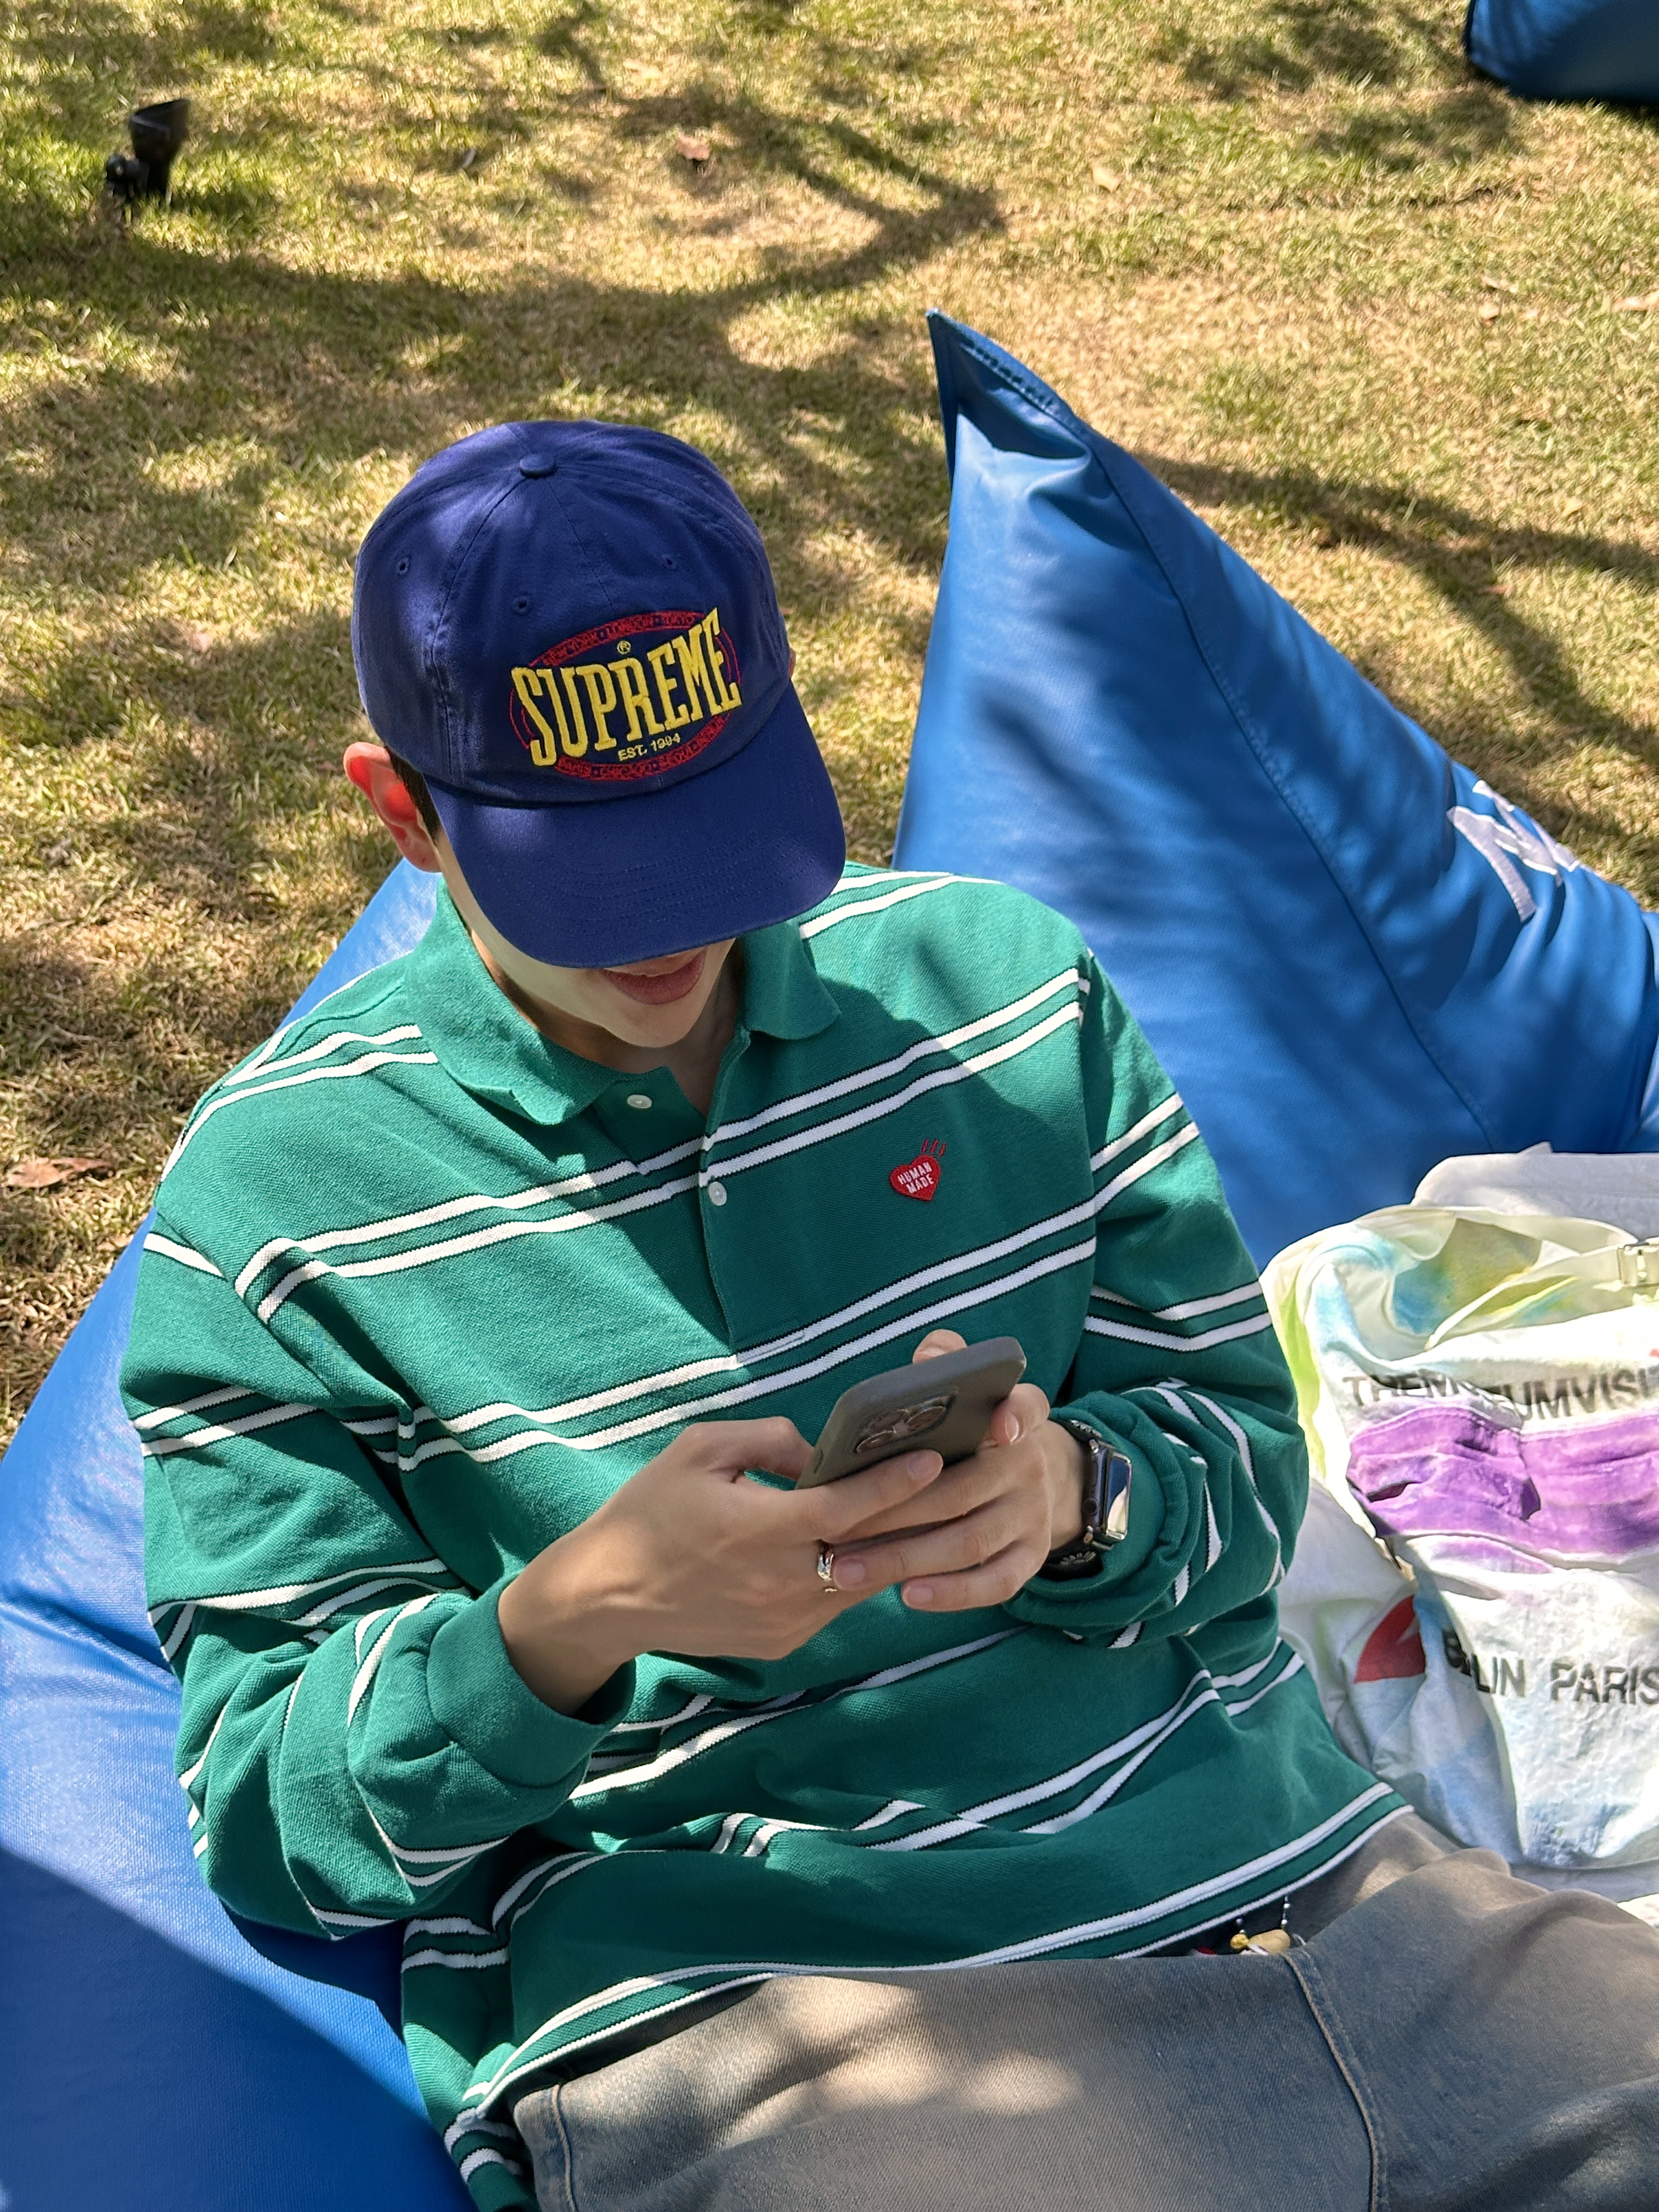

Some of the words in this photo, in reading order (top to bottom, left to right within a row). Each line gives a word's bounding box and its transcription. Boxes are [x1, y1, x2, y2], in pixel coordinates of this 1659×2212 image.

[511, 607, 742, 767] SUPREME
[650, 732, 681, 752] 1994
[898, 1161, 933, 1184] HUMAN
[906, 1173, 934, 1194] MADE
[1550, 1656, 1659, 1705] PARIS
